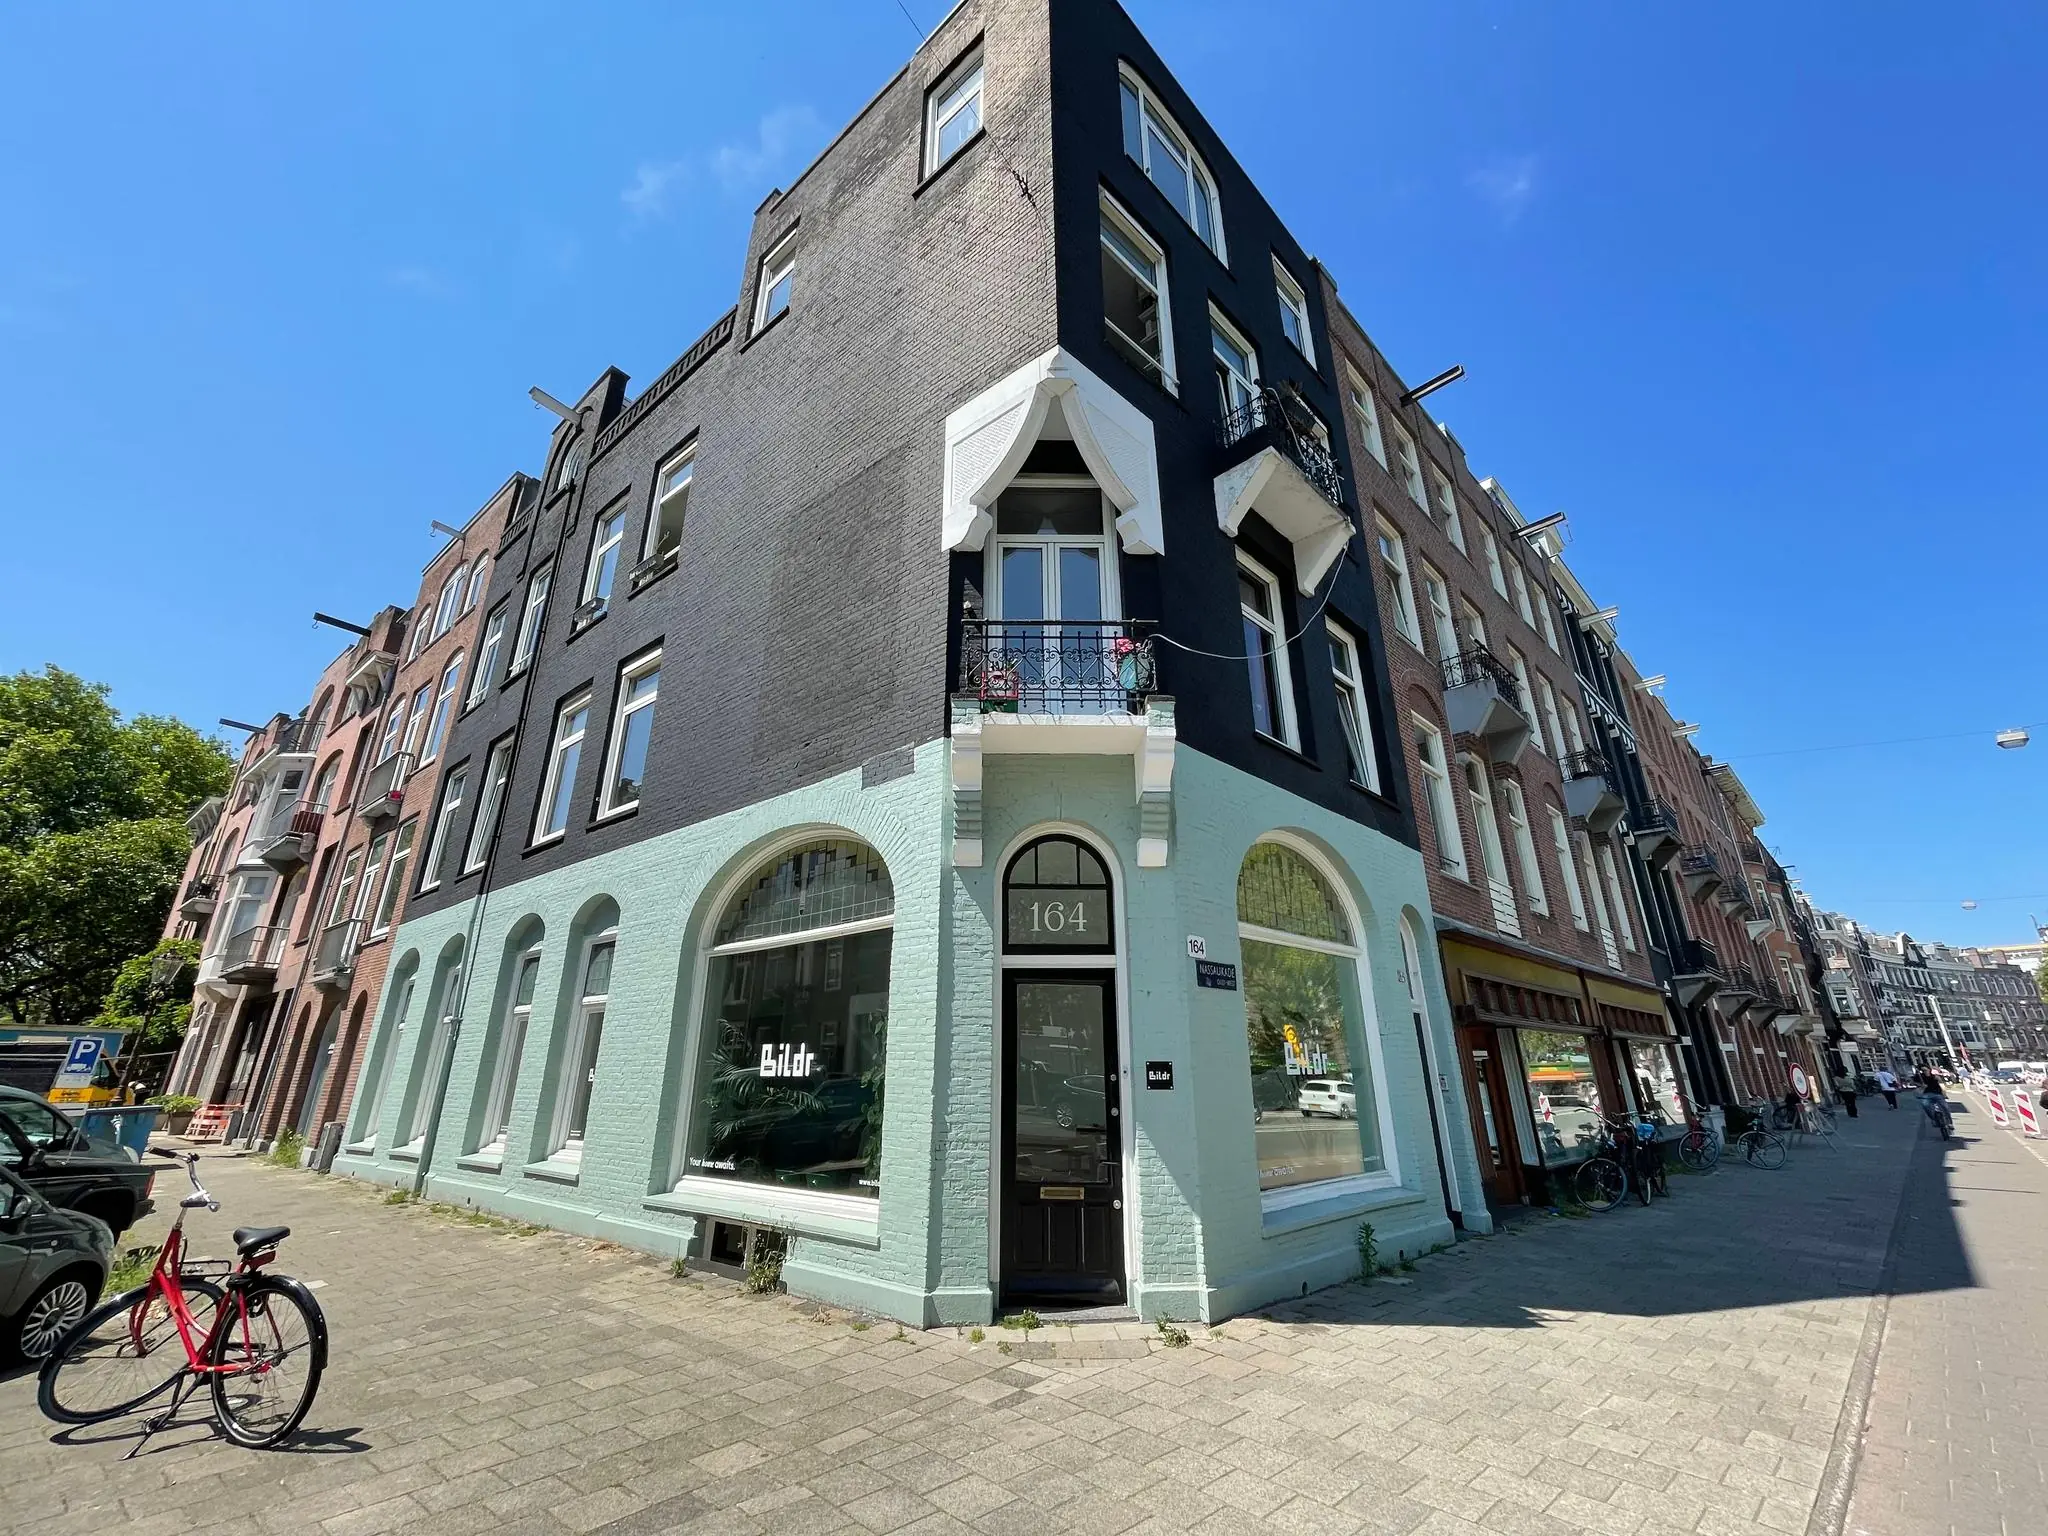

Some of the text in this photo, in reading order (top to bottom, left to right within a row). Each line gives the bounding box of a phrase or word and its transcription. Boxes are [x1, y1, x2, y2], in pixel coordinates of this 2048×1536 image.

[1030, 902, 1087, 932] 164
[1188, 939, 1204, 954] 164
[1199, 963, 1236, 979] NASSAUKADE
[75, 1041, 96, 1060] P
[760, 1042, 814, 1077] Bildr
[1148, 1070, 1171, 1080] Bildr
[689, 1157, 736, 1171] Your home awaits.
